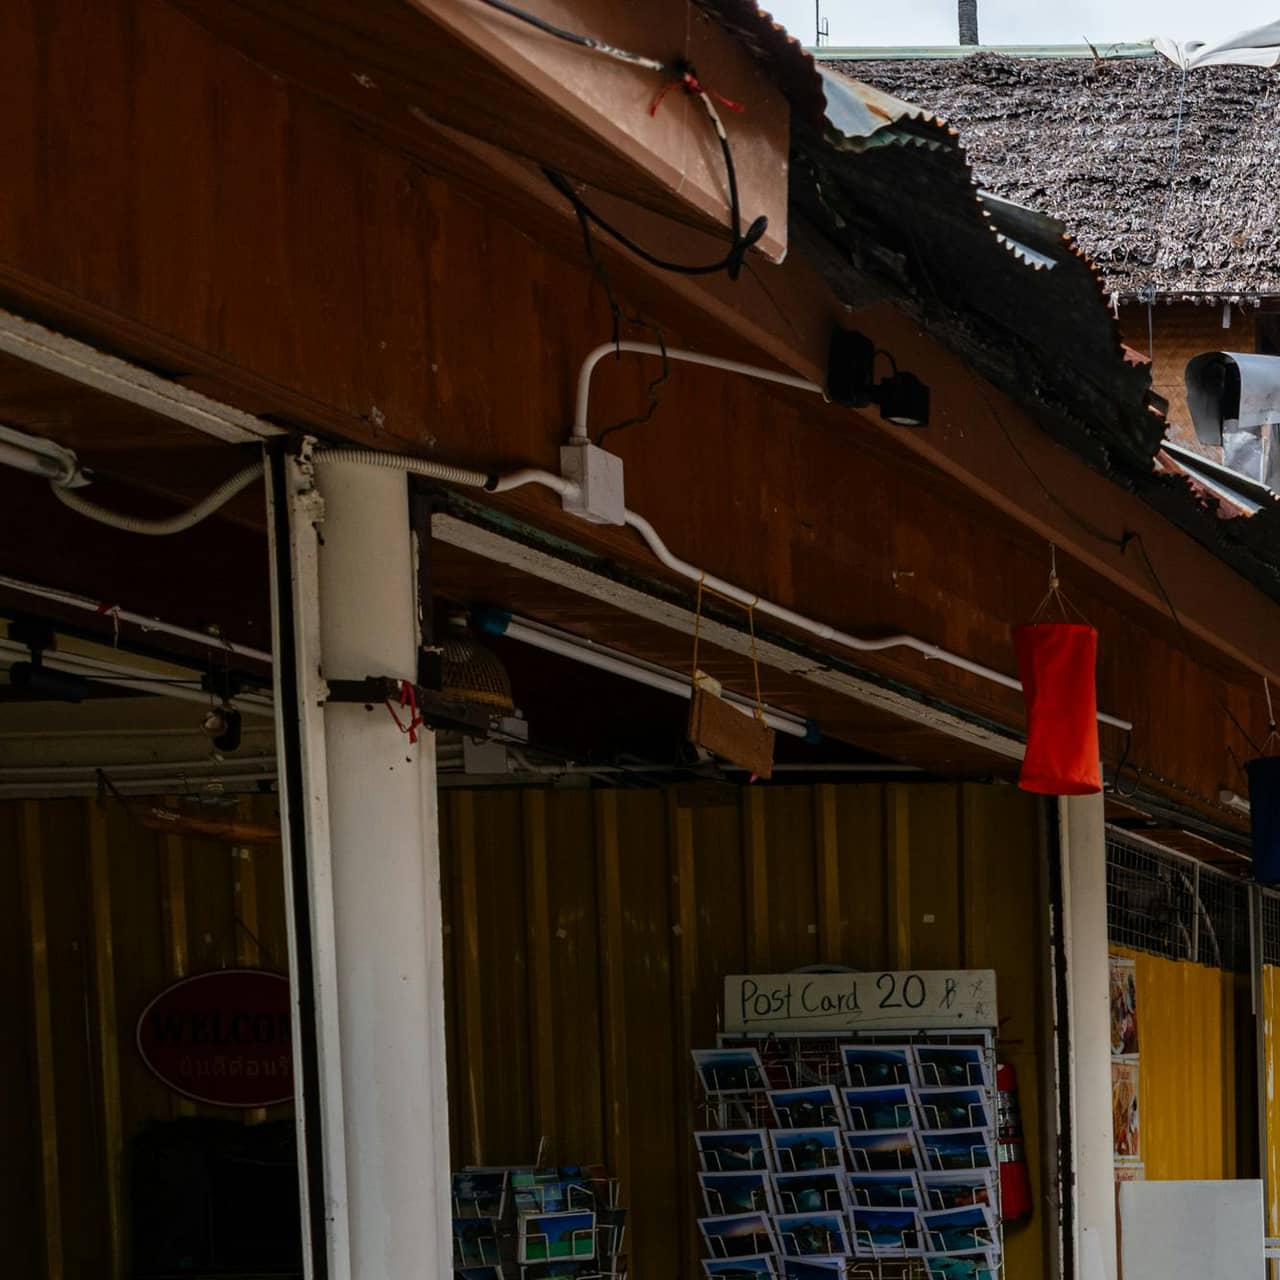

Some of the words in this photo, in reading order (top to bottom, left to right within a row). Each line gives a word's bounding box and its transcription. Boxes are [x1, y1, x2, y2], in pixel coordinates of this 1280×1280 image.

[741, 979, 792, 1018] Post
[801, 981, 861, 1012] Card
[876, 974, 926, 1009] 20
[152, 1010, 290, 1044] WELCO
